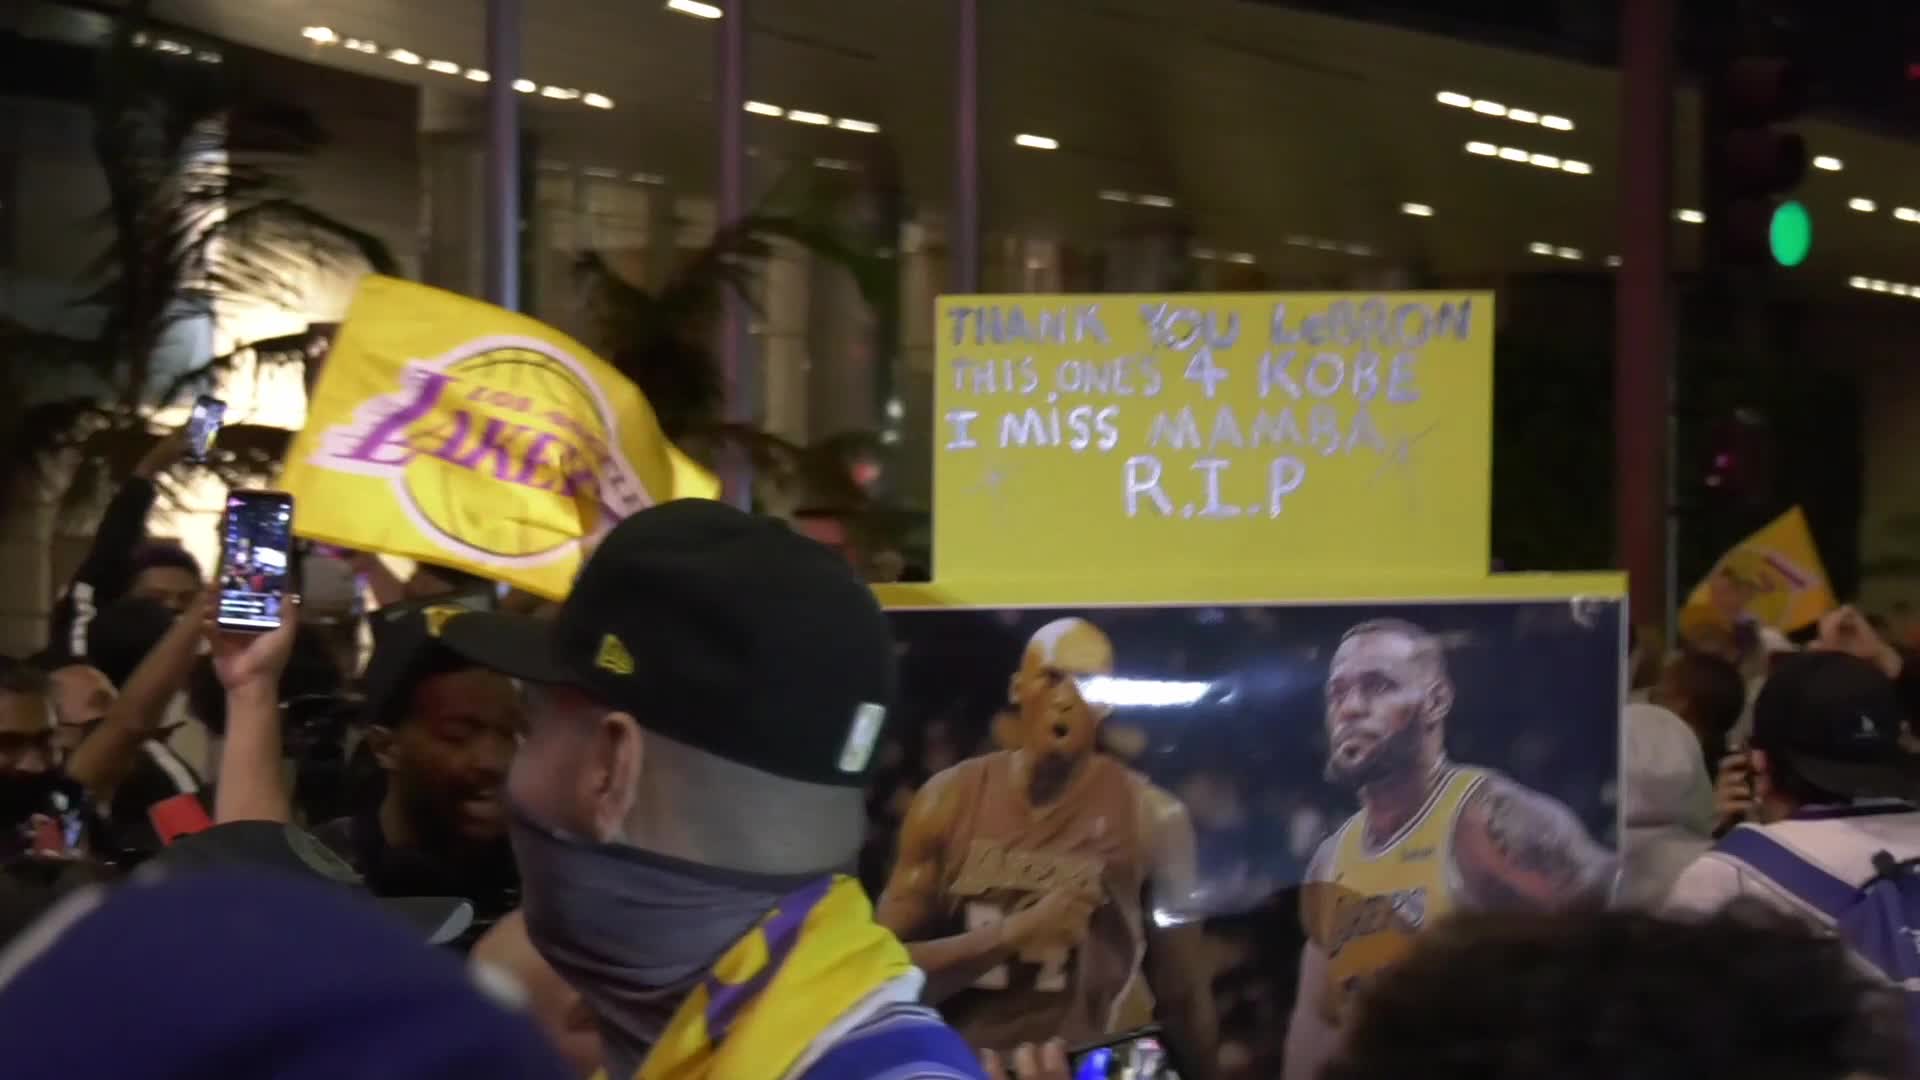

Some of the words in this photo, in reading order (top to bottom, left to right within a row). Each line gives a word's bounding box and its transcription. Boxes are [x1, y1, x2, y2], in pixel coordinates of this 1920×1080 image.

[947, 303, 1111, 347] THANK
[1140, 302, 1241, 351] YOU
[1271, 297, 1472, 349] LeBRON
[952, 356, 1038, 394] THIS
[1183, 348, 1229, 399] 4
[1258, 350, 1423, 404] KOBE
[945, 411, 979, 450] I
[1148, 404, 1386, 457] MAMBA
[1122, 453, 1306, 520] R.I.P
